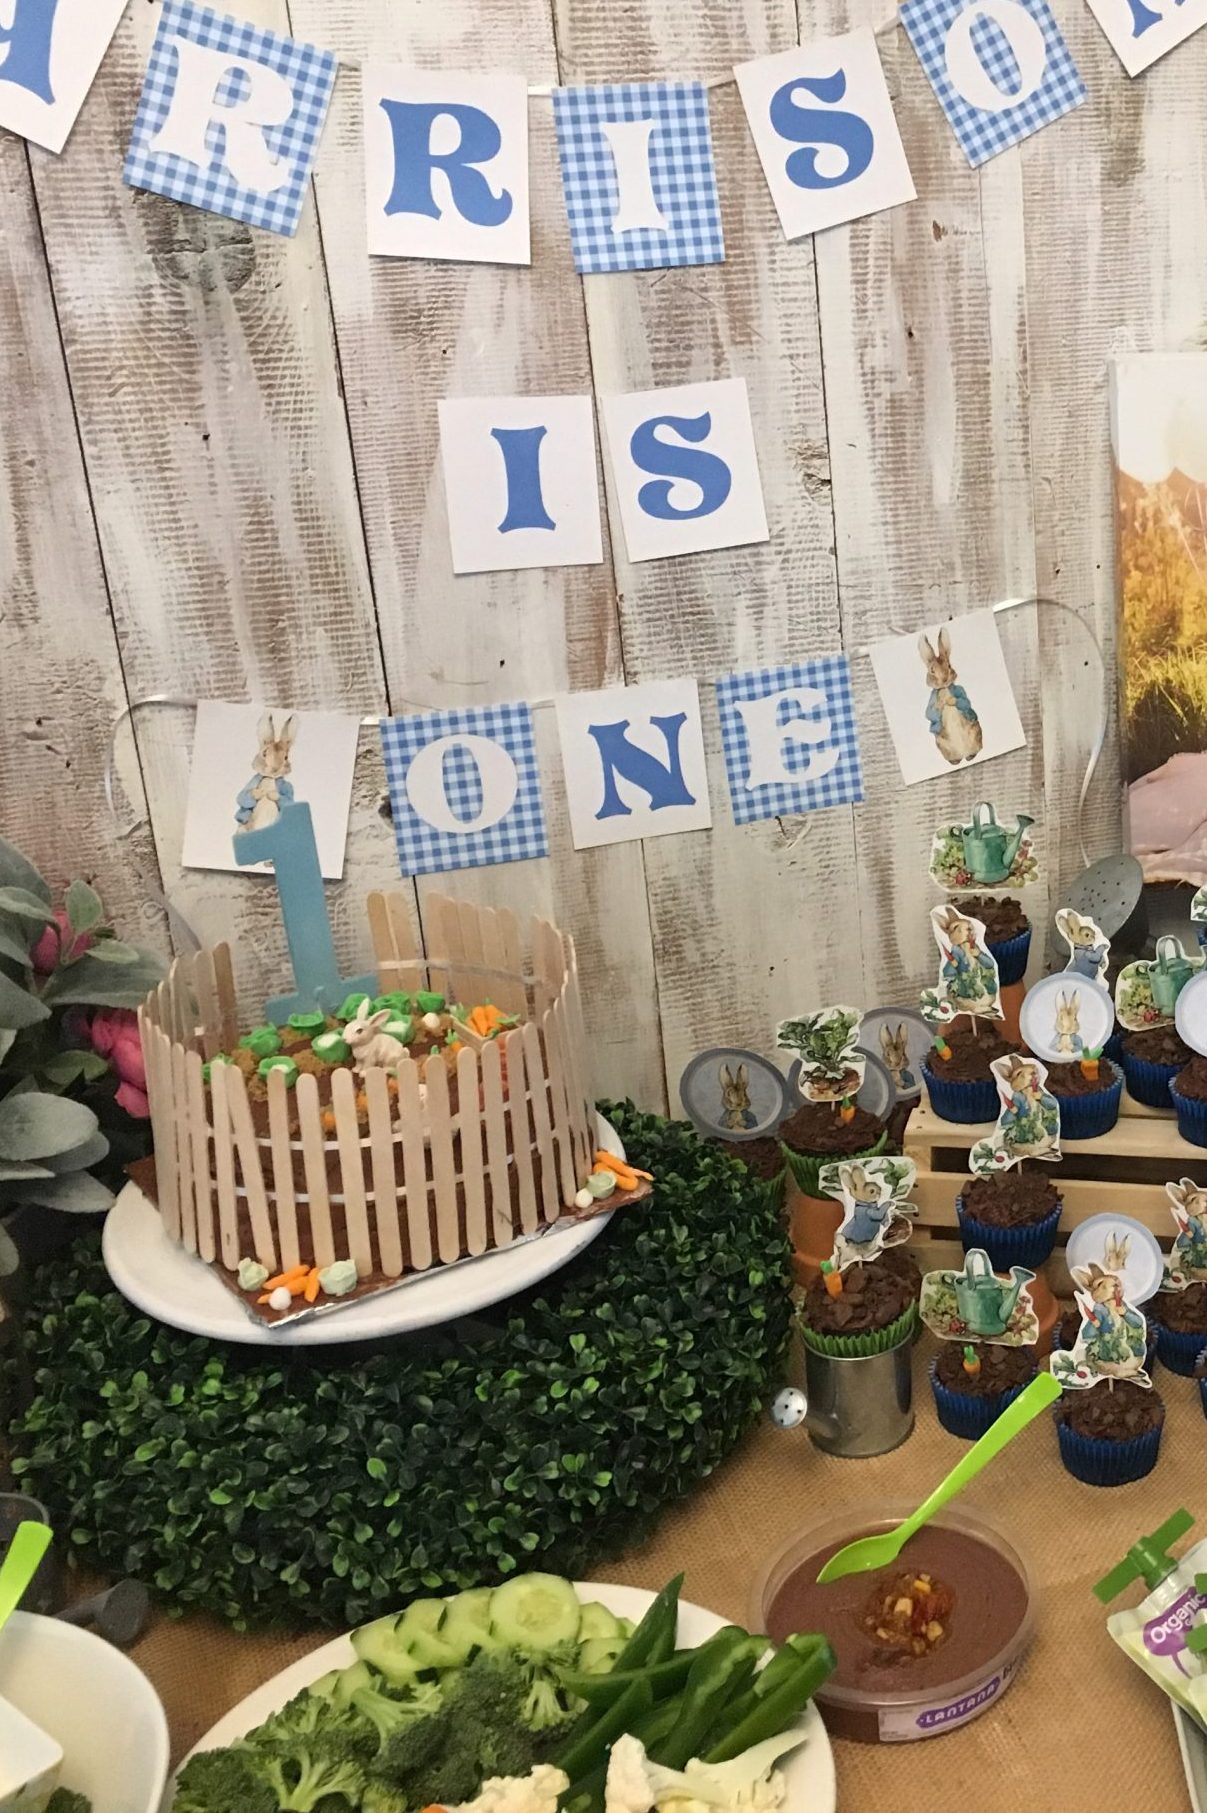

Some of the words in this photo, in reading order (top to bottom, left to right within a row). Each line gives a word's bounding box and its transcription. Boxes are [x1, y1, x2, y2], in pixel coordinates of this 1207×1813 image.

[490, 411, 732, 534] IS
[406, 686, 842, 835] ONE
[1150, 1593, 1206, 1644] Organic
